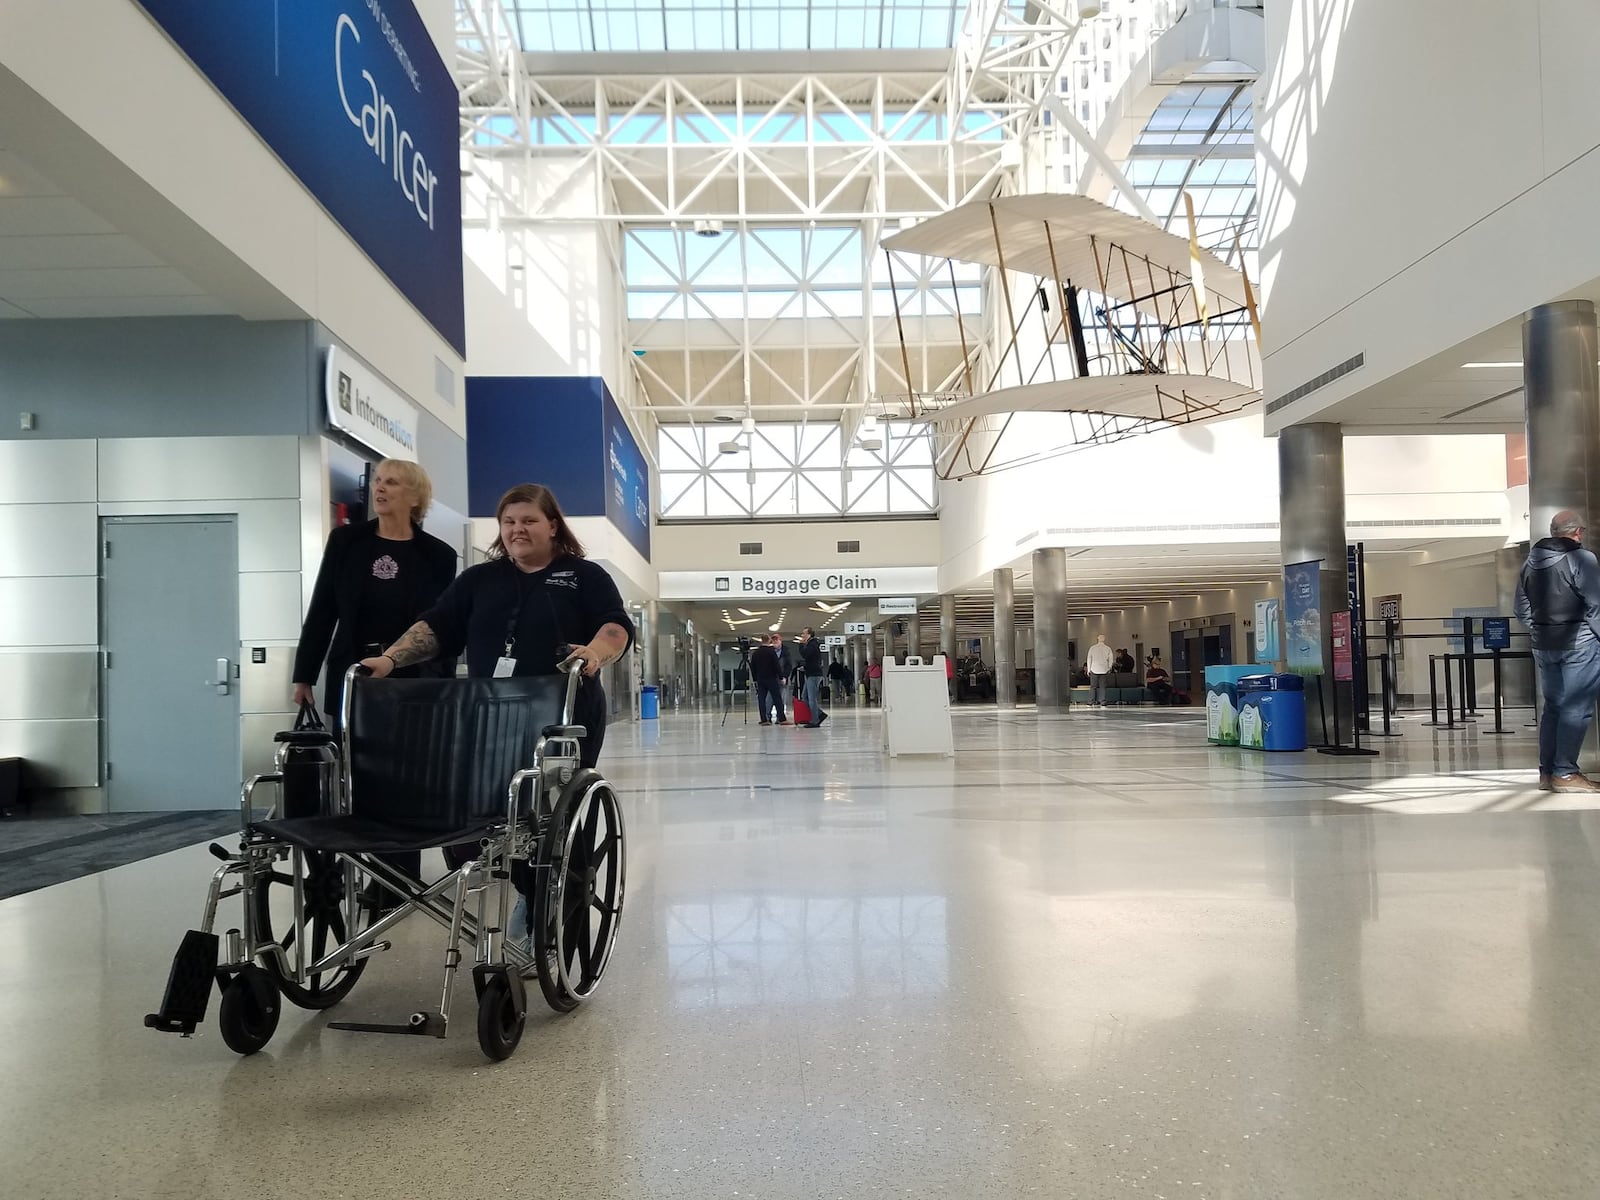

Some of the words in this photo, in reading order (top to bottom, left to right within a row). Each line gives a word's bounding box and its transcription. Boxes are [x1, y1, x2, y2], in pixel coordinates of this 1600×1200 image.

[335, 13, 438, 230] Cancer
[355, 388, 413, 452] Information
[742, 576, 820, 594] Baggage
[826, 575, 877, 589] Claim
